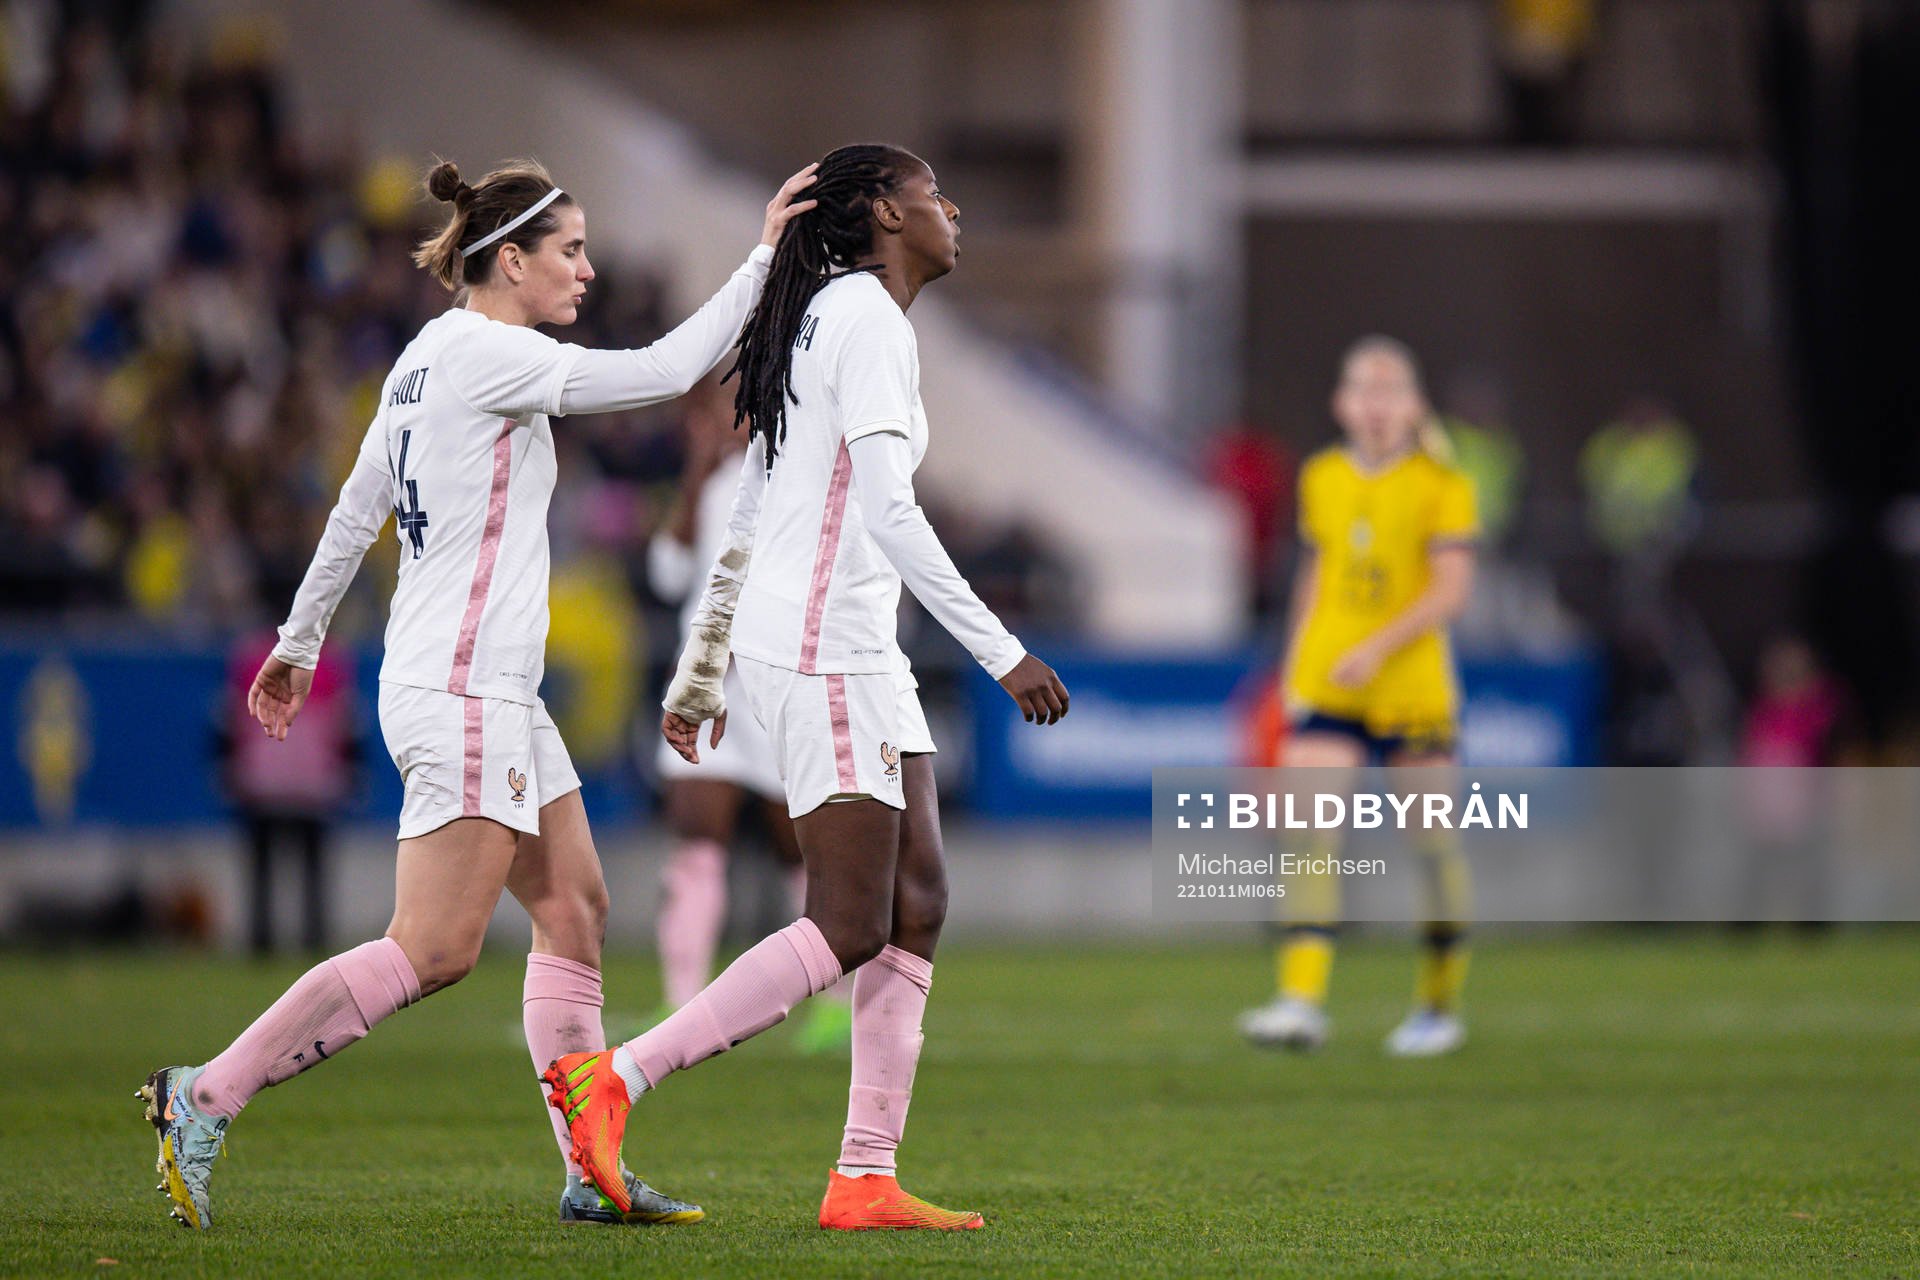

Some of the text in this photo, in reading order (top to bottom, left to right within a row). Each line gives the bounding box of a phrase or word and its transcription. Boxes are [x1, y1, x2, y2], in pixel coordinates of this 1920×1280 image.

[796, 313, 820, 352] RA
[389, 366, 430, 407] AULT
[388, 429, 429, 560] 4
